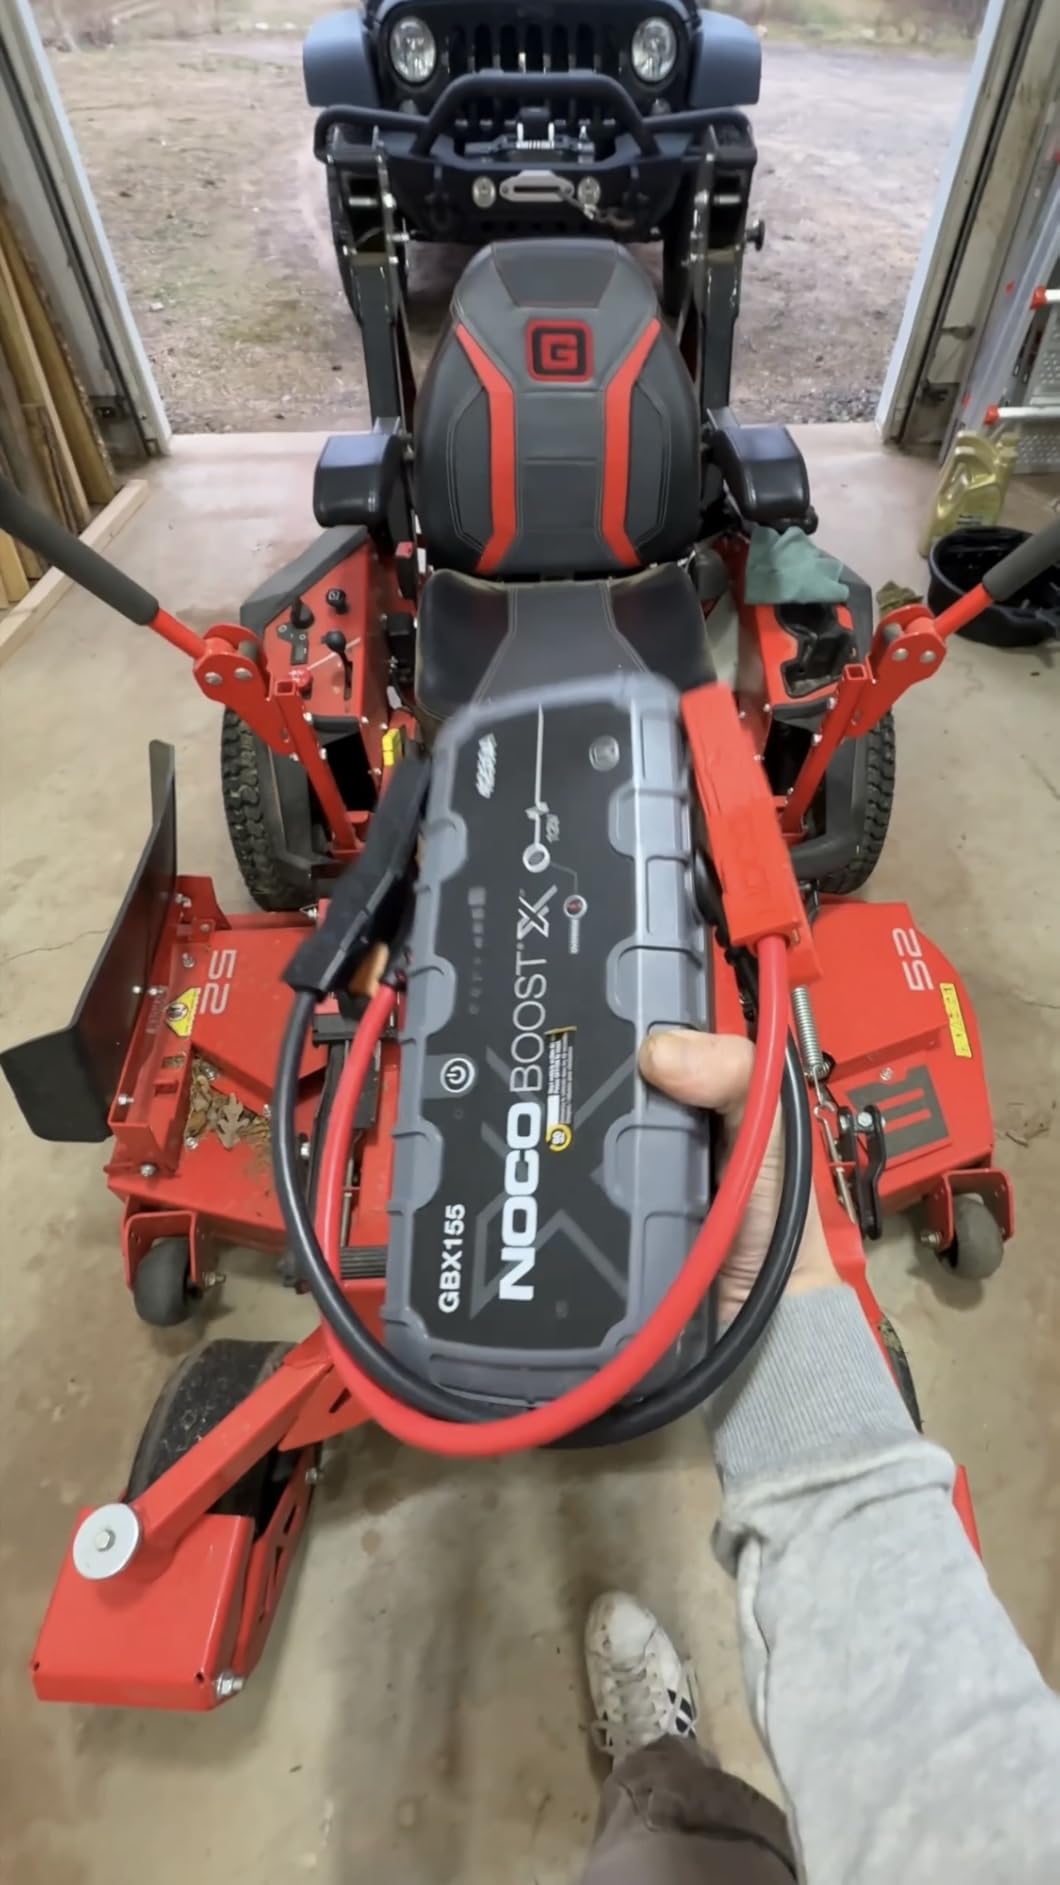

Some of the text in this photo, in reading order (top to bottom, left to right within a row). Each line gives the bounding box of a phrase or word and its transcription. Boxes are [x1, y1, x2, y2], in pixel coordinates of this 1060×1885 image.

[199, 949, 237, 1015] 52
[891, 927, 936, 992] 52
[499, 884, 558, 1301] NOCO BOOST X
[438, 1204, 466, 1314] GBX155
